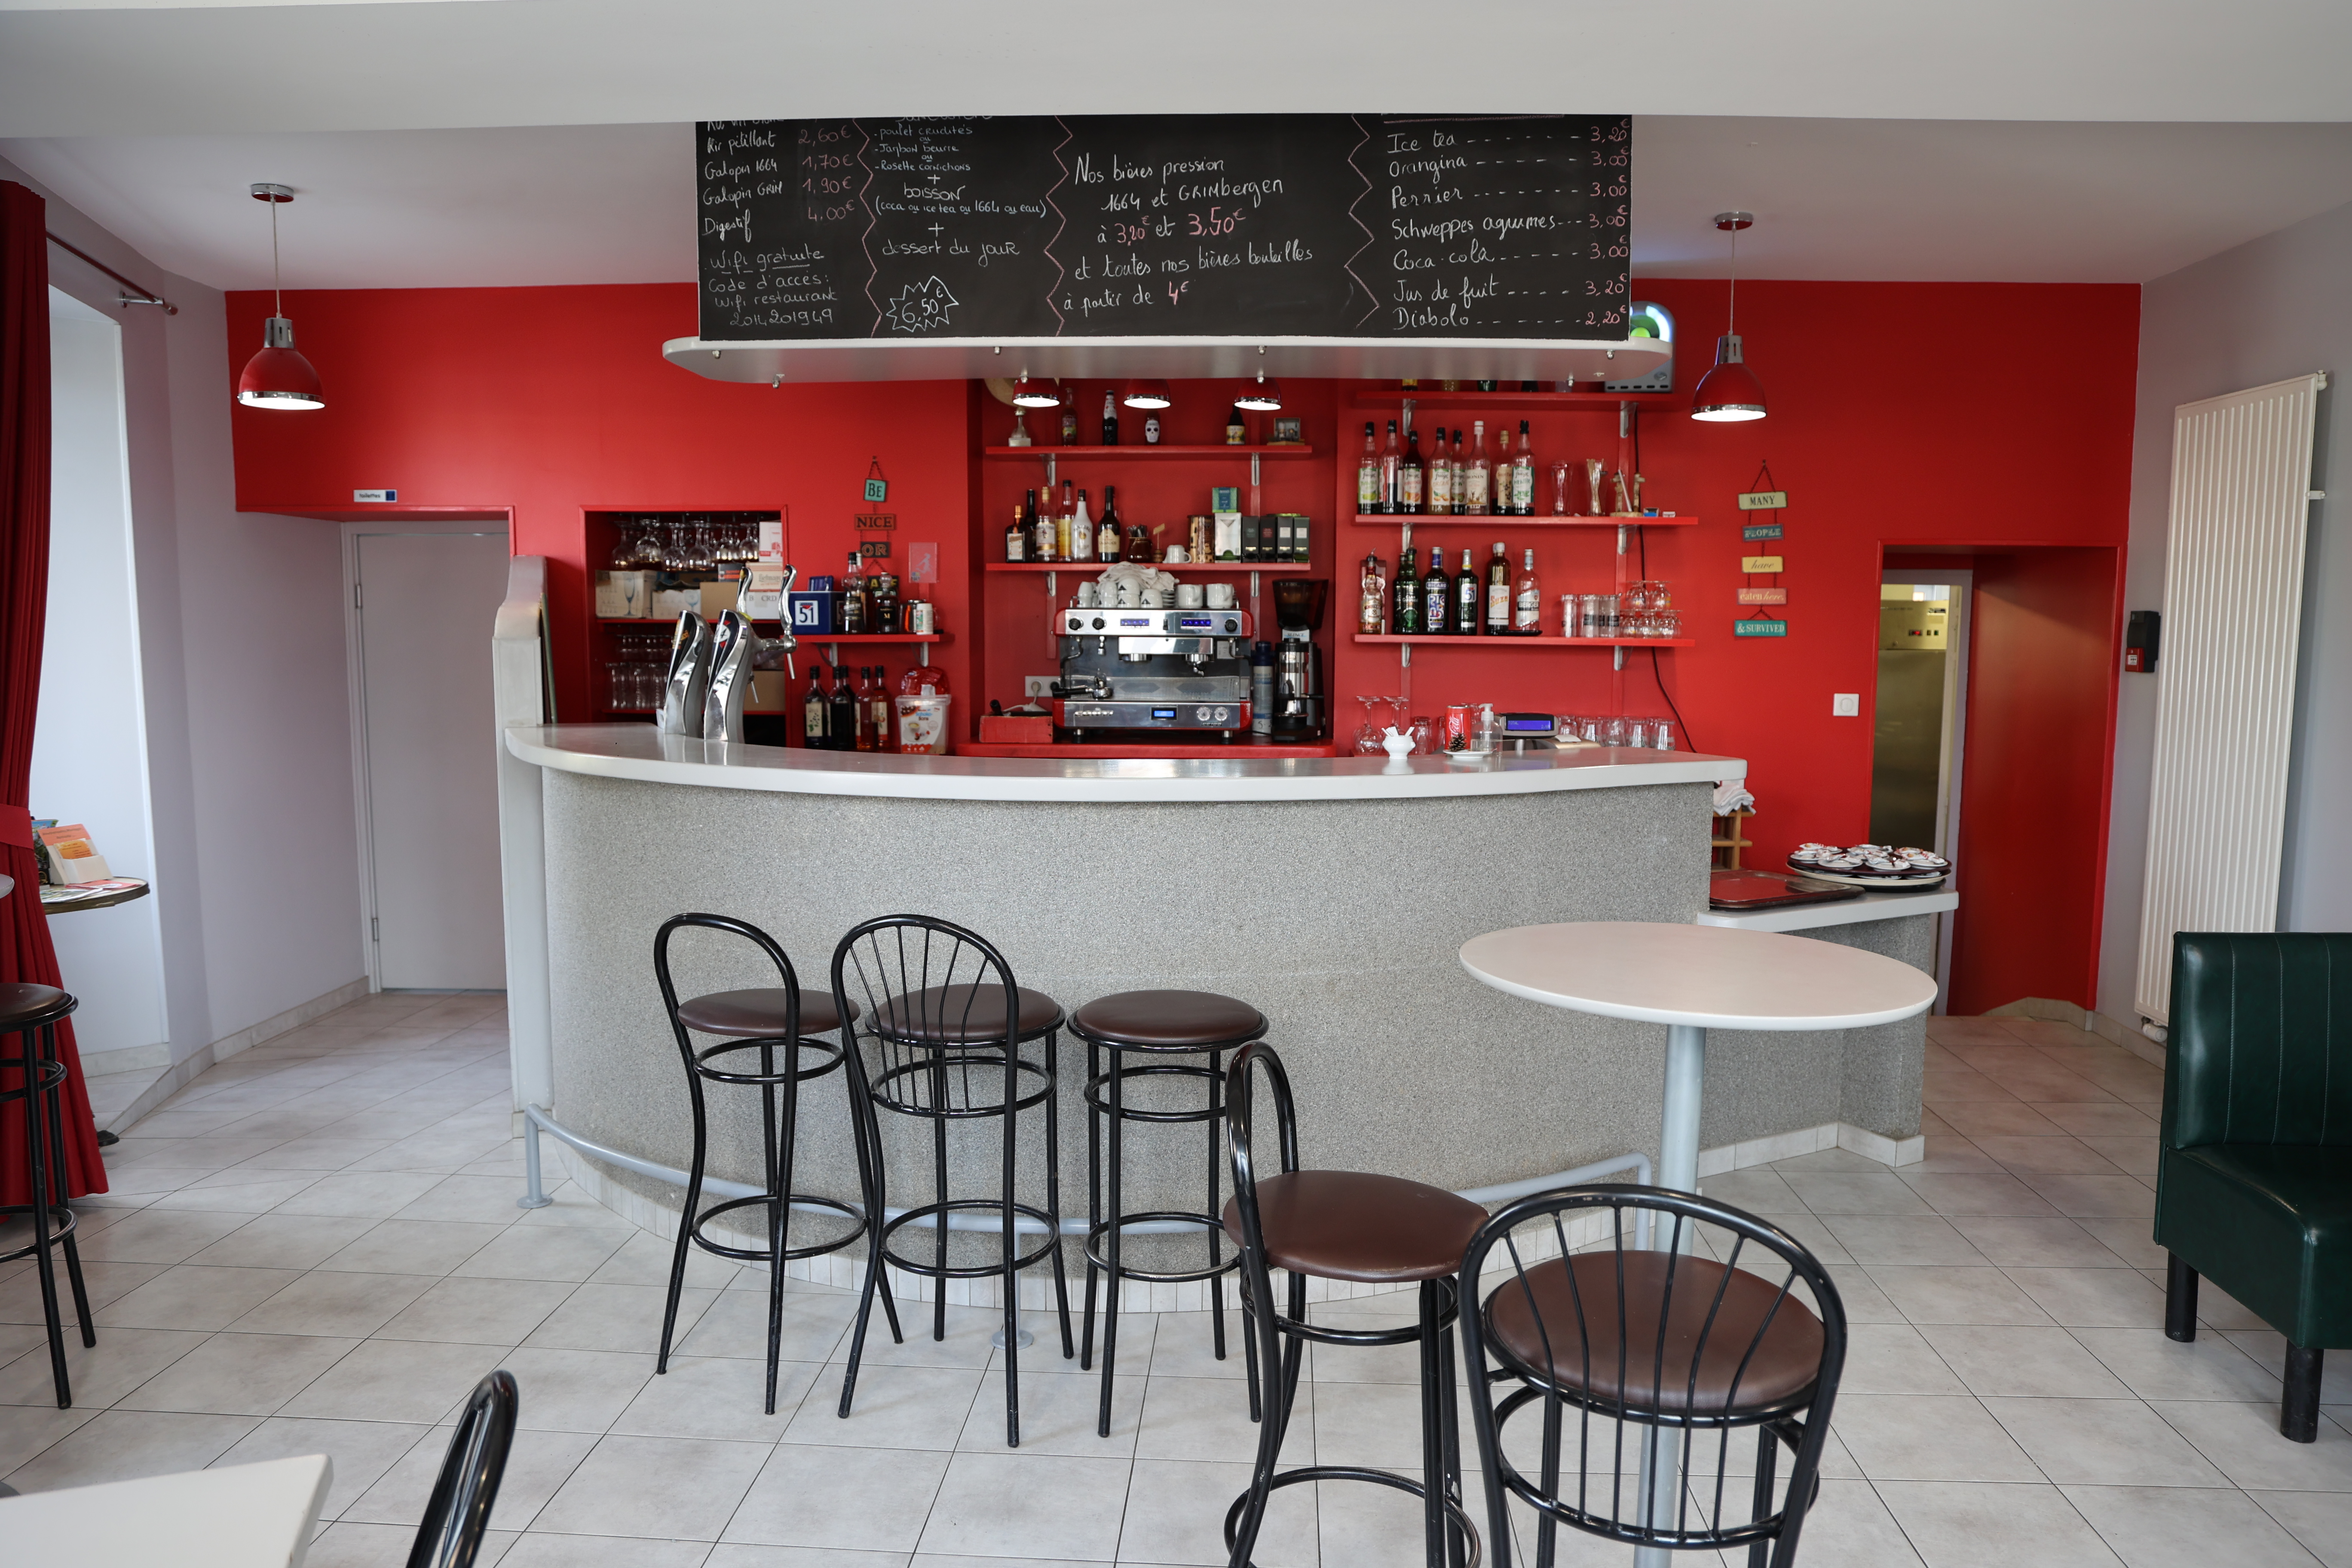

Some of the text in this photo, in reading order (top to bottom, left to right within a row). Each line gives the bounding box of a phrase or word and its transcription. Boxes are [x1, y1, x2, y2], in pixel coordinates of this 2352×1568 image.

[1387, 129, 1458, 153] Ice tea
[704, 160, 750, 183] Galopin
[756, 158, 778, 172] 1664
[1075, 153, 1104, 185] Nos
[1163, 156, 1225, 184] pression
[1390, 155, 1468, 184] Orangina
[703, 186, 752, 209] Galopin
[923, 204, 936, 212] ice
[939, 203, 956, 213] tea
[975, 199, 999, 213] 1664
[1101, 192, 1140, 212] 1664
[1152, 187, 1169, 207] et
[1391, 185, 1464, 210] Perrier
[1096, 225, 1108, 243] à
[1155, 215, 1176, 237] et
[1391, 217, 1474, 243] Schweppes
[756, 243, 825, 272] gratuite
[882, 239, 942, 255] dessert
[949, 238, 970, 254] du
[1075, 255, 1091, 280] et
[1102, 253, 1152, 277] toutes
[1161, 257, 1190, 273] nos
[708, 279, 746, 293] Code
[1393, 279, 1423, 302] Jus
[1431, 279, 1450, 301] de
[1063, 292, 1074, 310] à
[1080, 288, 1123, 317] partir
[1132, 283, 1155, 305] de
[1392, 303, 1469, 330] Diabolo
[867, 483, 882, 498] BE
[1750, 496, 1775, 506] MANY
[856, 516, 893, 528] NICE
[1744, 528, 1782, 538] PEOPLE
[861, 544, 887, 556] OR
[1751, 559, 1774, 570] have
[1464, 589, 1476, 600] 51
[1490, 595, 1509, 608] Suze
[1740, 592, 1763, 600] eaten
[799, 606, 814, 623] 51
